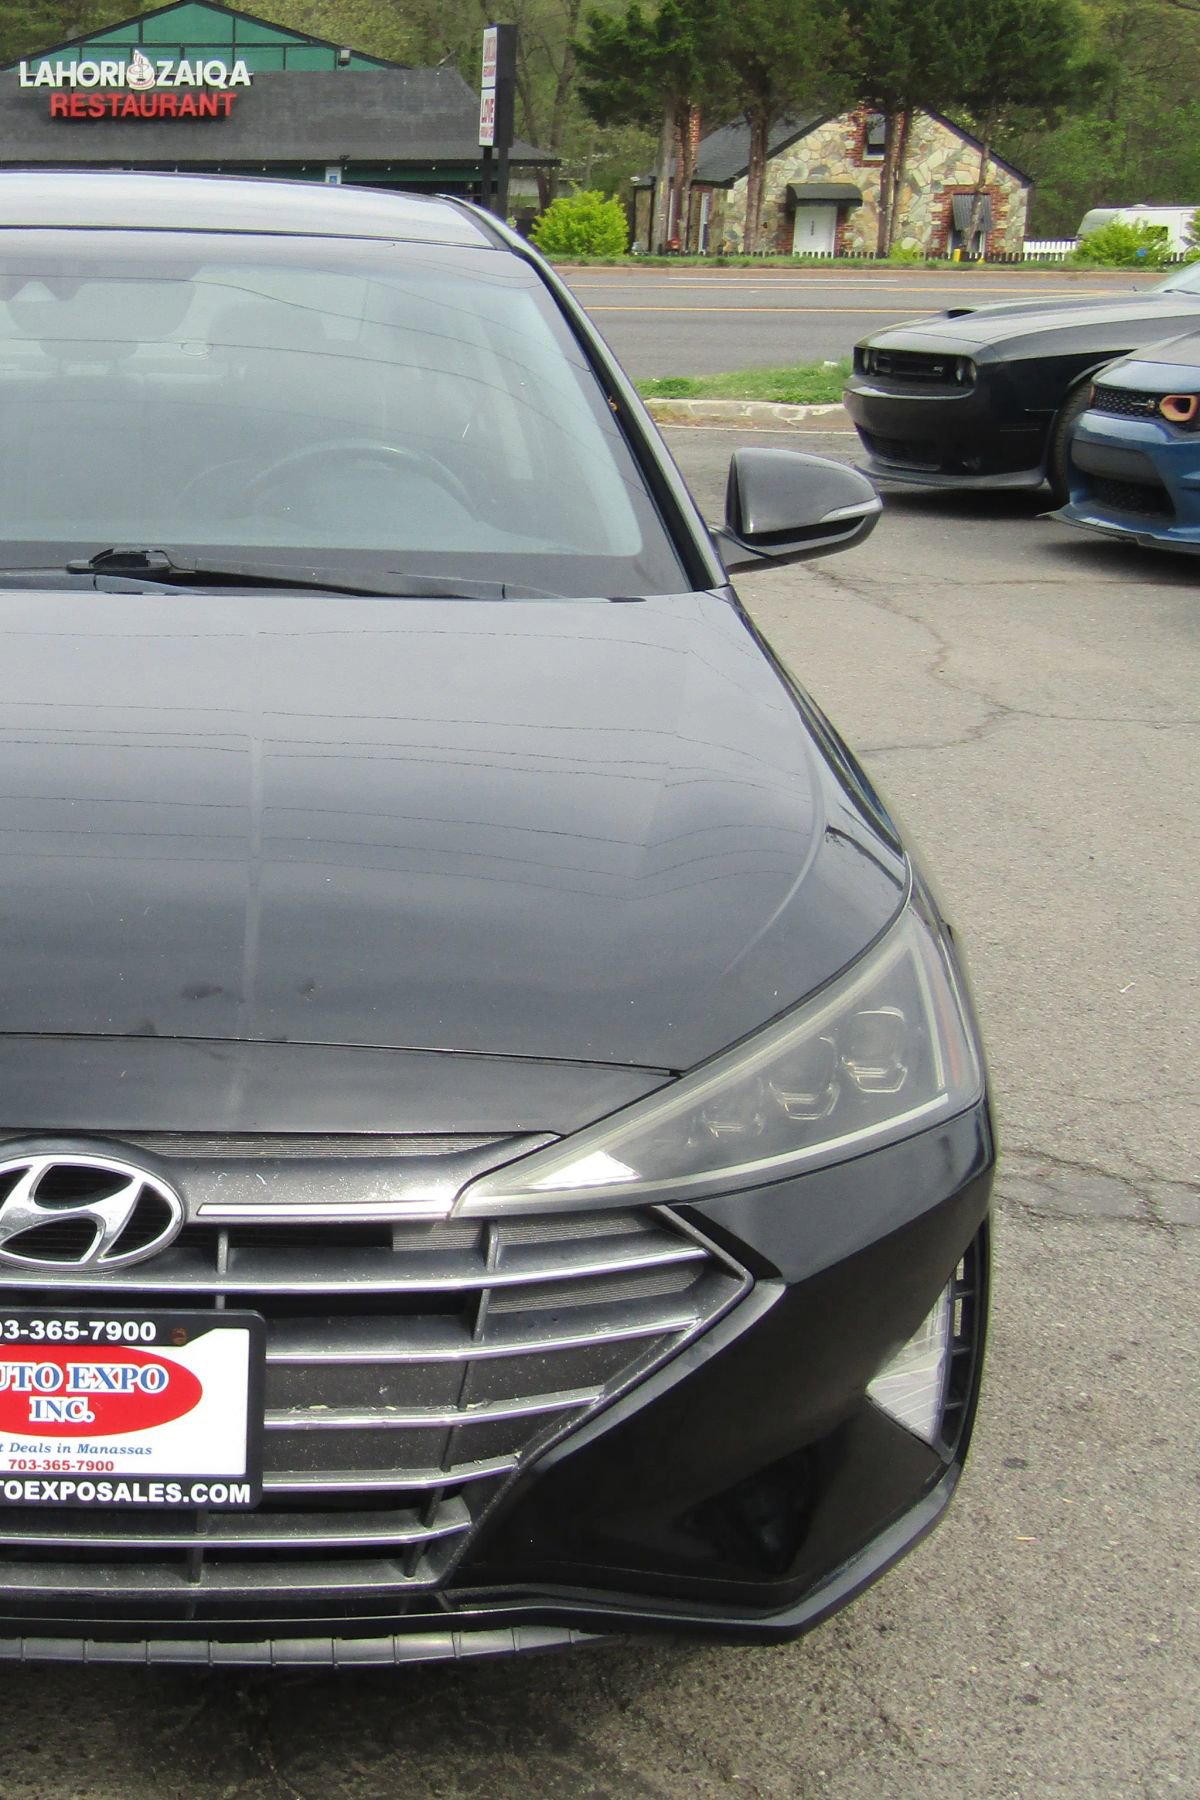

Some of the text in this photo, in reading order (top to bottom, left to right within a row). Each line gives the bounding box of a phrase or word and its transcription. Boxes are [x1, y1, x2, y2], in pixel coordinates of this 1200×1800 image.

[19, 60, 251, 89] LAHORI ZAIQA
[50, 93, 236, 118] RESTAURANT
[66, 1363, 169, 1393] EXPO
[29, 1396, 94, 1423] INC.
[9, 1441, 52, 1454] Deals
[57, 1442, 72, 1454] in
[76, 1442, 153, 1456] Manassas
[8, 1458, 114, 1472] 703-365-7900
